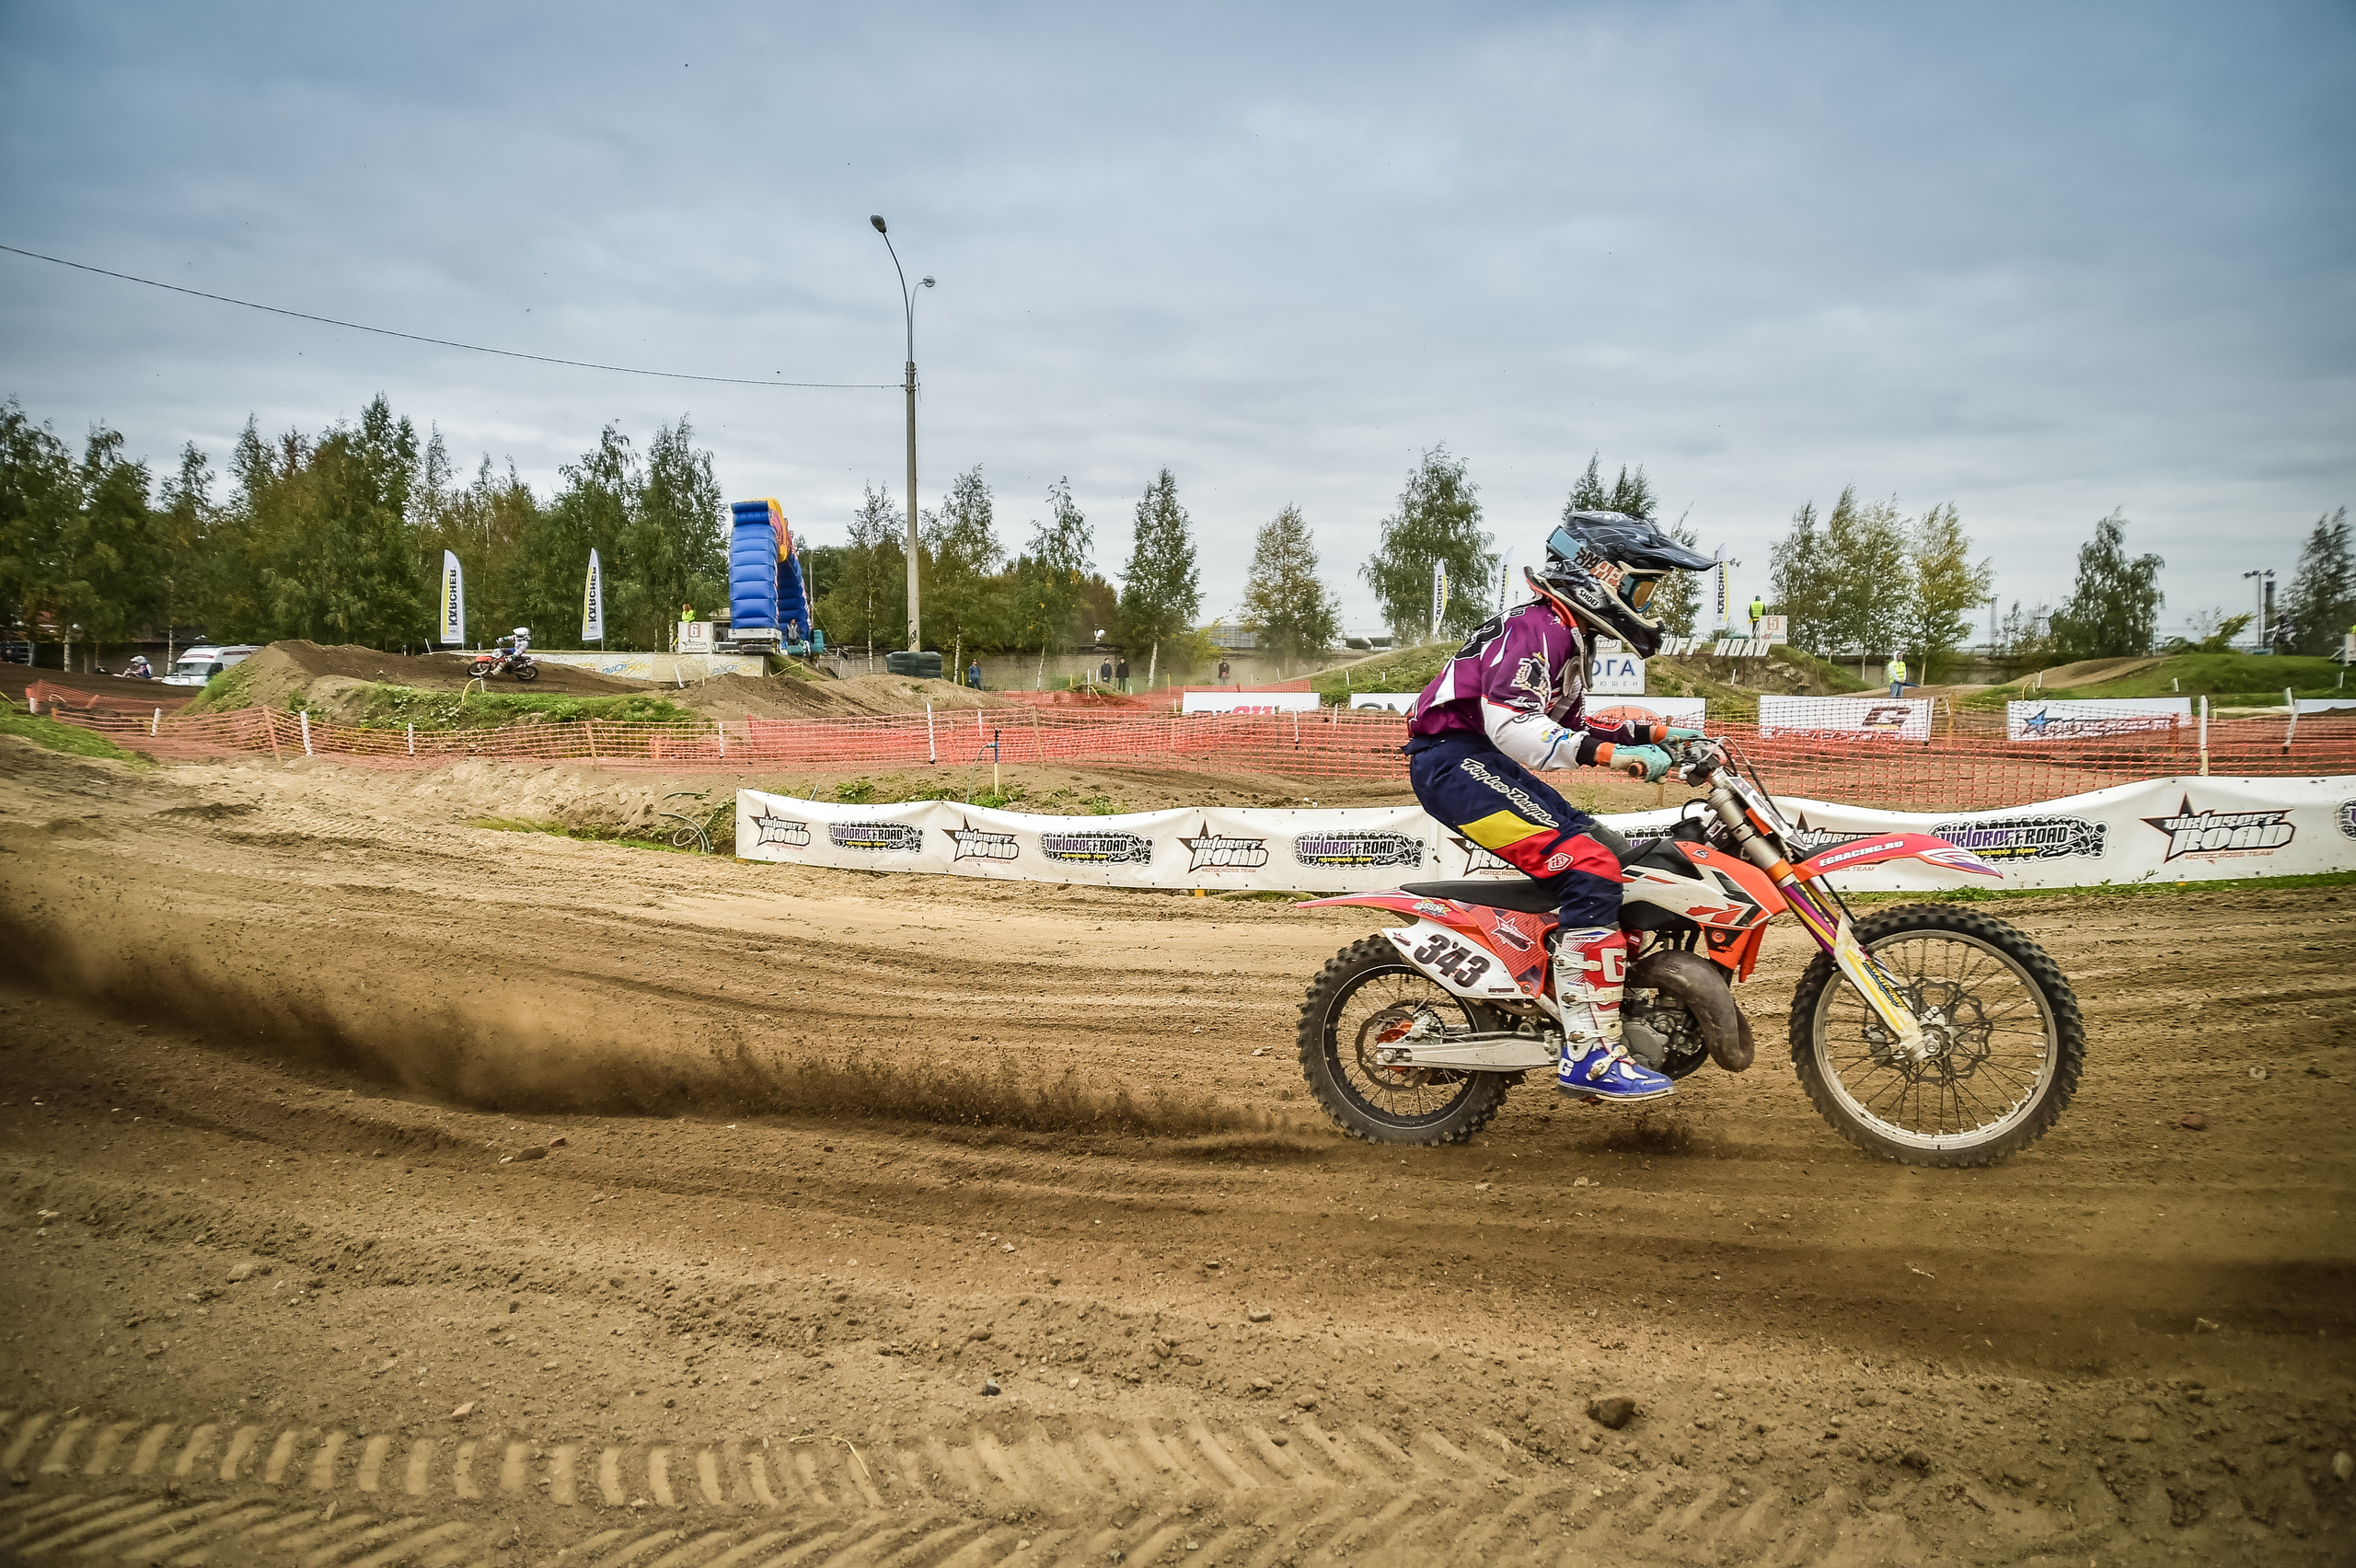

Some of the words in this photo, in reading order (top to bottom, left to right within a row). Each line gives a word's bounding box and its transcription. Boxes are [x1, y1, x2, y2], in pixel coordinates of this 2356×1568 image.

[1578, 589, 1600, 608] SHOEI
[690, 624, 699, 637] 6
[1769, 617, 1778, 629] 5
[1658, 637, 1704, 656] OFF
[1714, 638, 1773, 657] ROAD
[1507, 788, 1559, 828] Designs
[760, 828, 811, 847] ROAD
[2170, 825, 2294, 858] ROAD
[958, 840, 1020, 859] ROAD
[1190, 848, 1268, 868] ROAD
[1819, 840, 1904, 867] EGRACING.RU
[2185, 852, 2246, 860] MOTOCROSS
[1414, 934, 1491, 987] 343
[1558, 1058, 1575, 1077] G
